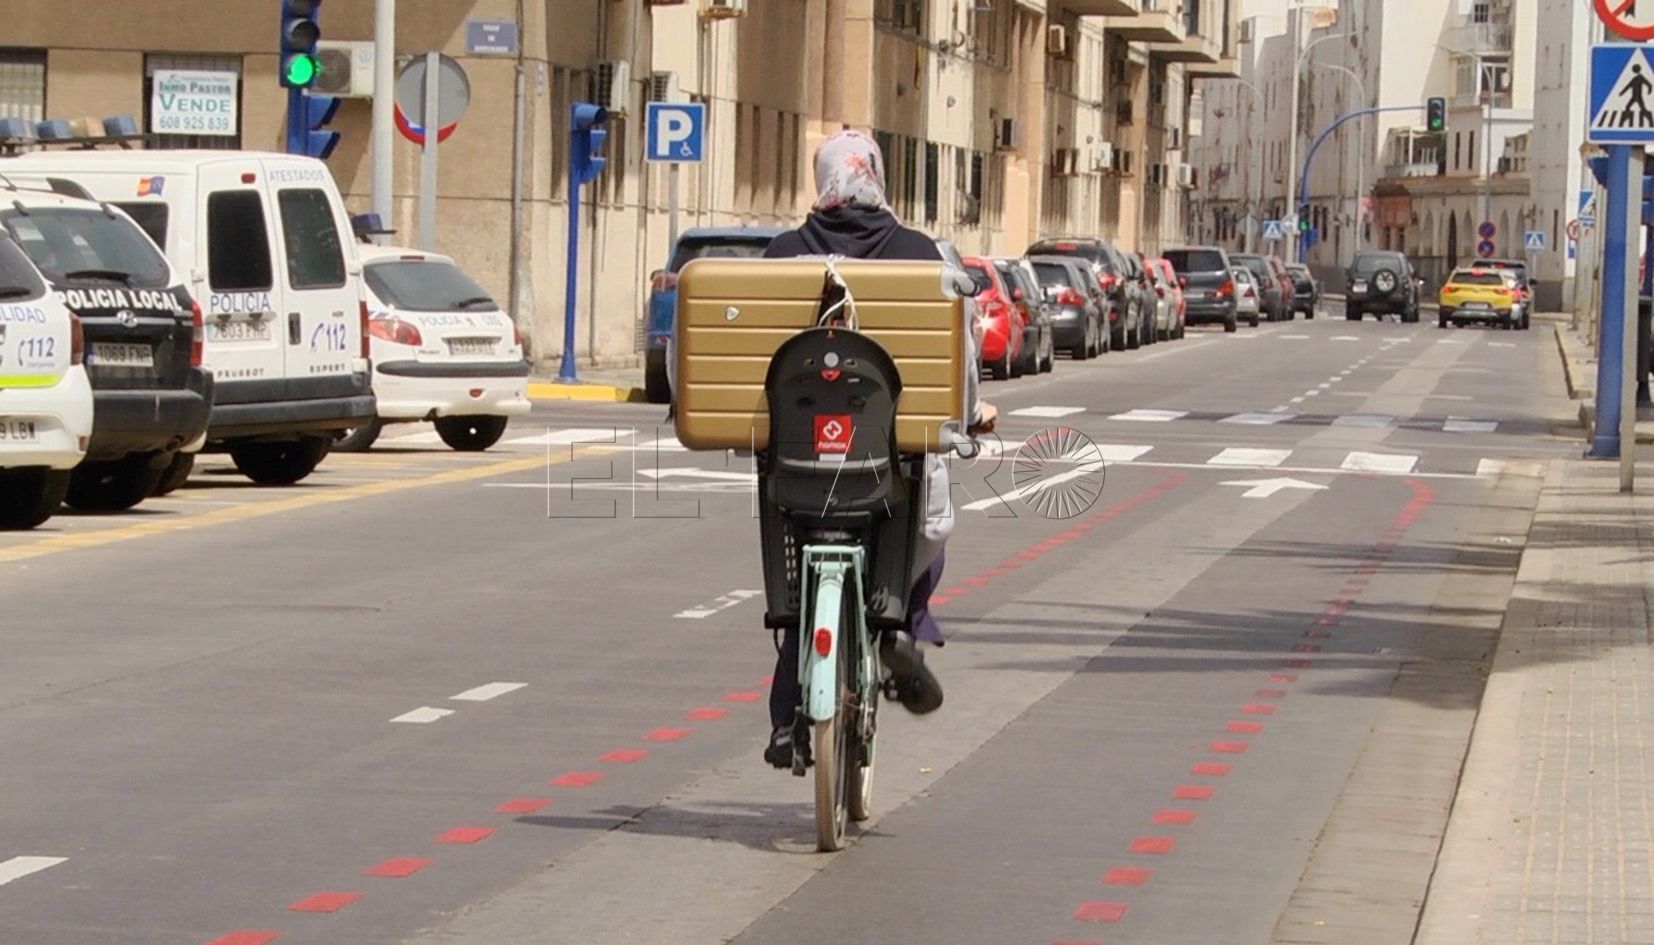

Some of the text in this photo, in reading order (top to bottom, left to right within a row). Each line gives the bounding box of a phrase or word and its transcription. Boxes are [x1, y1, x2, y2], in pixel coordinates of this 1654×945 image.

[160, 115, 229, 130] 608 925 839
[656, 109, 693, 156] P
[269, 169, 325, 181] ATESTADOS
[129, 290, 183, 312] LOCAL
[210, 292, 271, 313] POLICIA
[26, 336, 55, 358] 112
[326, 322, 346, 351] 112
